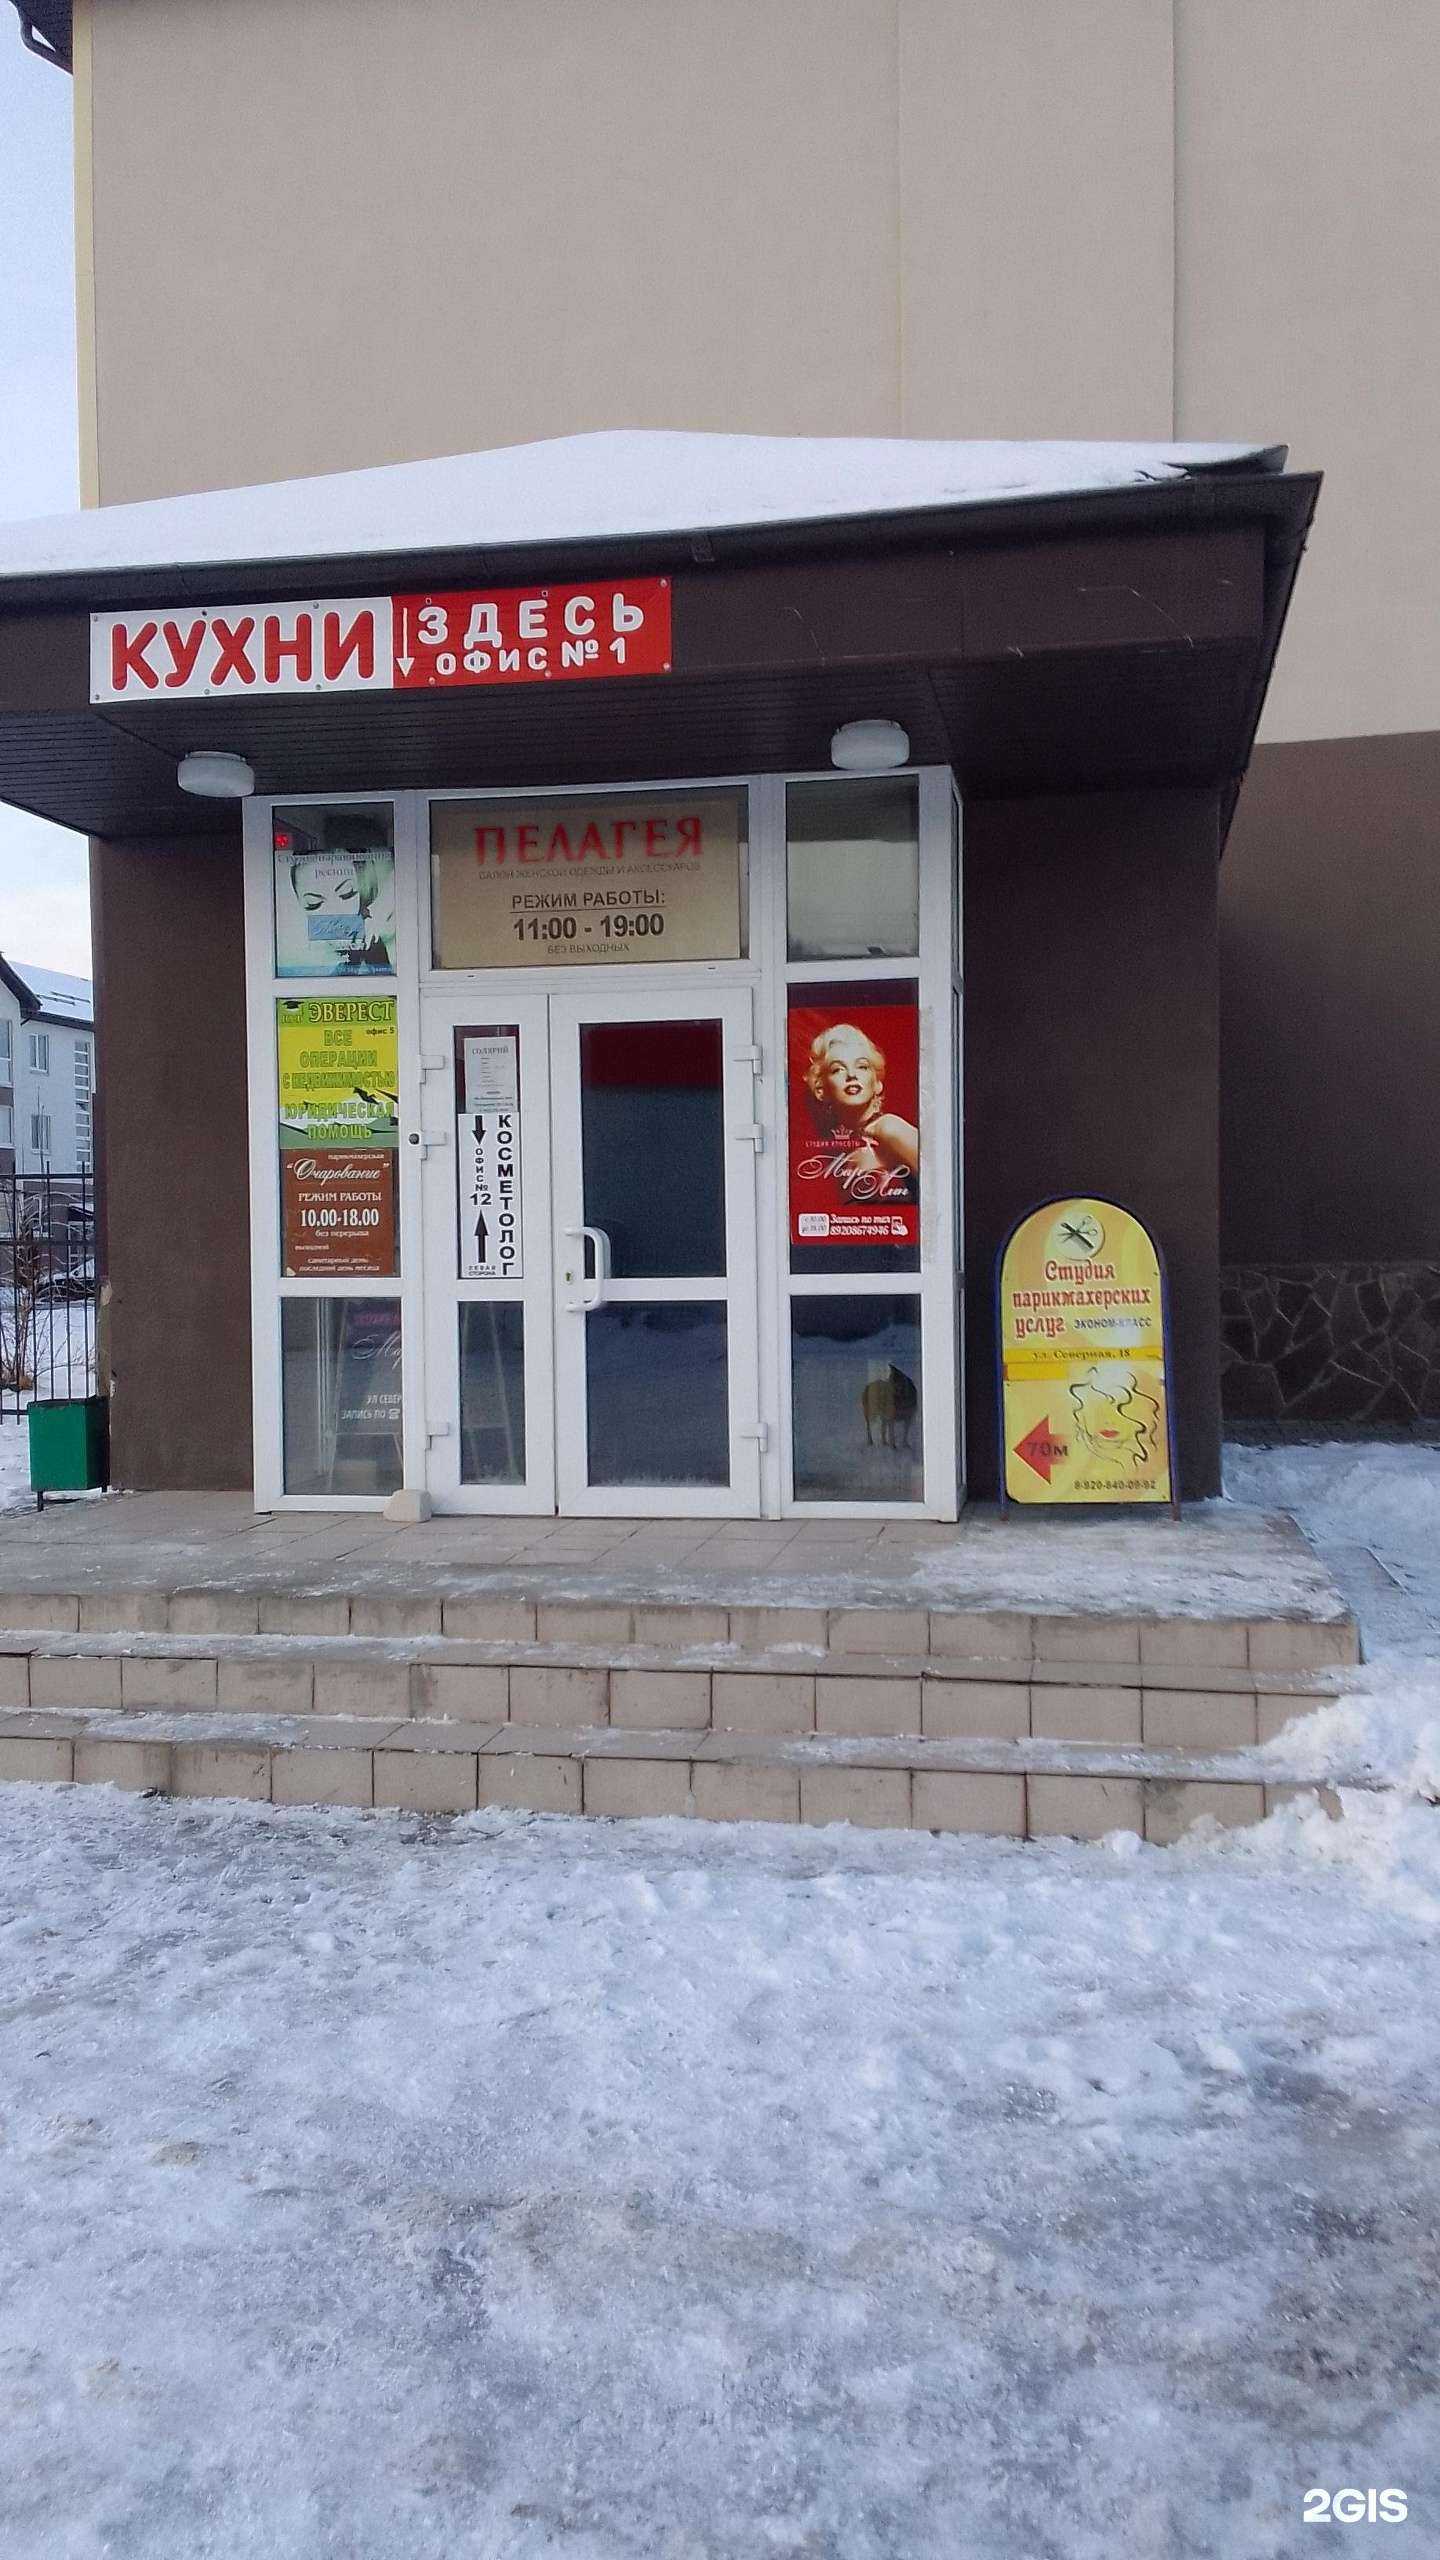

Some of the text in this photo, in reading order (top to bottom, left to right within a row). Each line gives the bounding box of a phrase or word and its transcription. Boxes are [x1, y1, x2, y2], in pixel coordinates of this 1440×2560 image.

[417, 593, 645, 649] ЗДЕСЬ
[111, 610, 376, 691] КУХНИ
[435, 637, 626, 676] ОФИС № 1
[474, 815, 705, 866] ПЕЛАГЕЯ
[512, 888, 665, 910] РЕЖИМ РАБОТЫ:
[513, 916, 577, 941] 11:00
[600, 912, 664, 938] 19:00
[309, 1001, 394, 1022] ЭВЕРЕСТ
[323, 1029, 352, 1047] ВСЕ
[389, 1026, 395, 1034] 5
[299, 1050, 377, 1069] ОПЕРАЦИИ
[475, 1147, 484, 1182] ОФИС
[299, 1191, 382, 1202] РЕЖИМ РАБОТЫ
[470, 1193, 492, 1205] 12
[497, 1114, 515, 1276] КОСМЕТОЛОГ
[1045, 1259, 1115, 1285] Студия
[1012, 1288, 1151, 1312] парикмахерских
[1016, 1317, 1065, 1338] услуг
